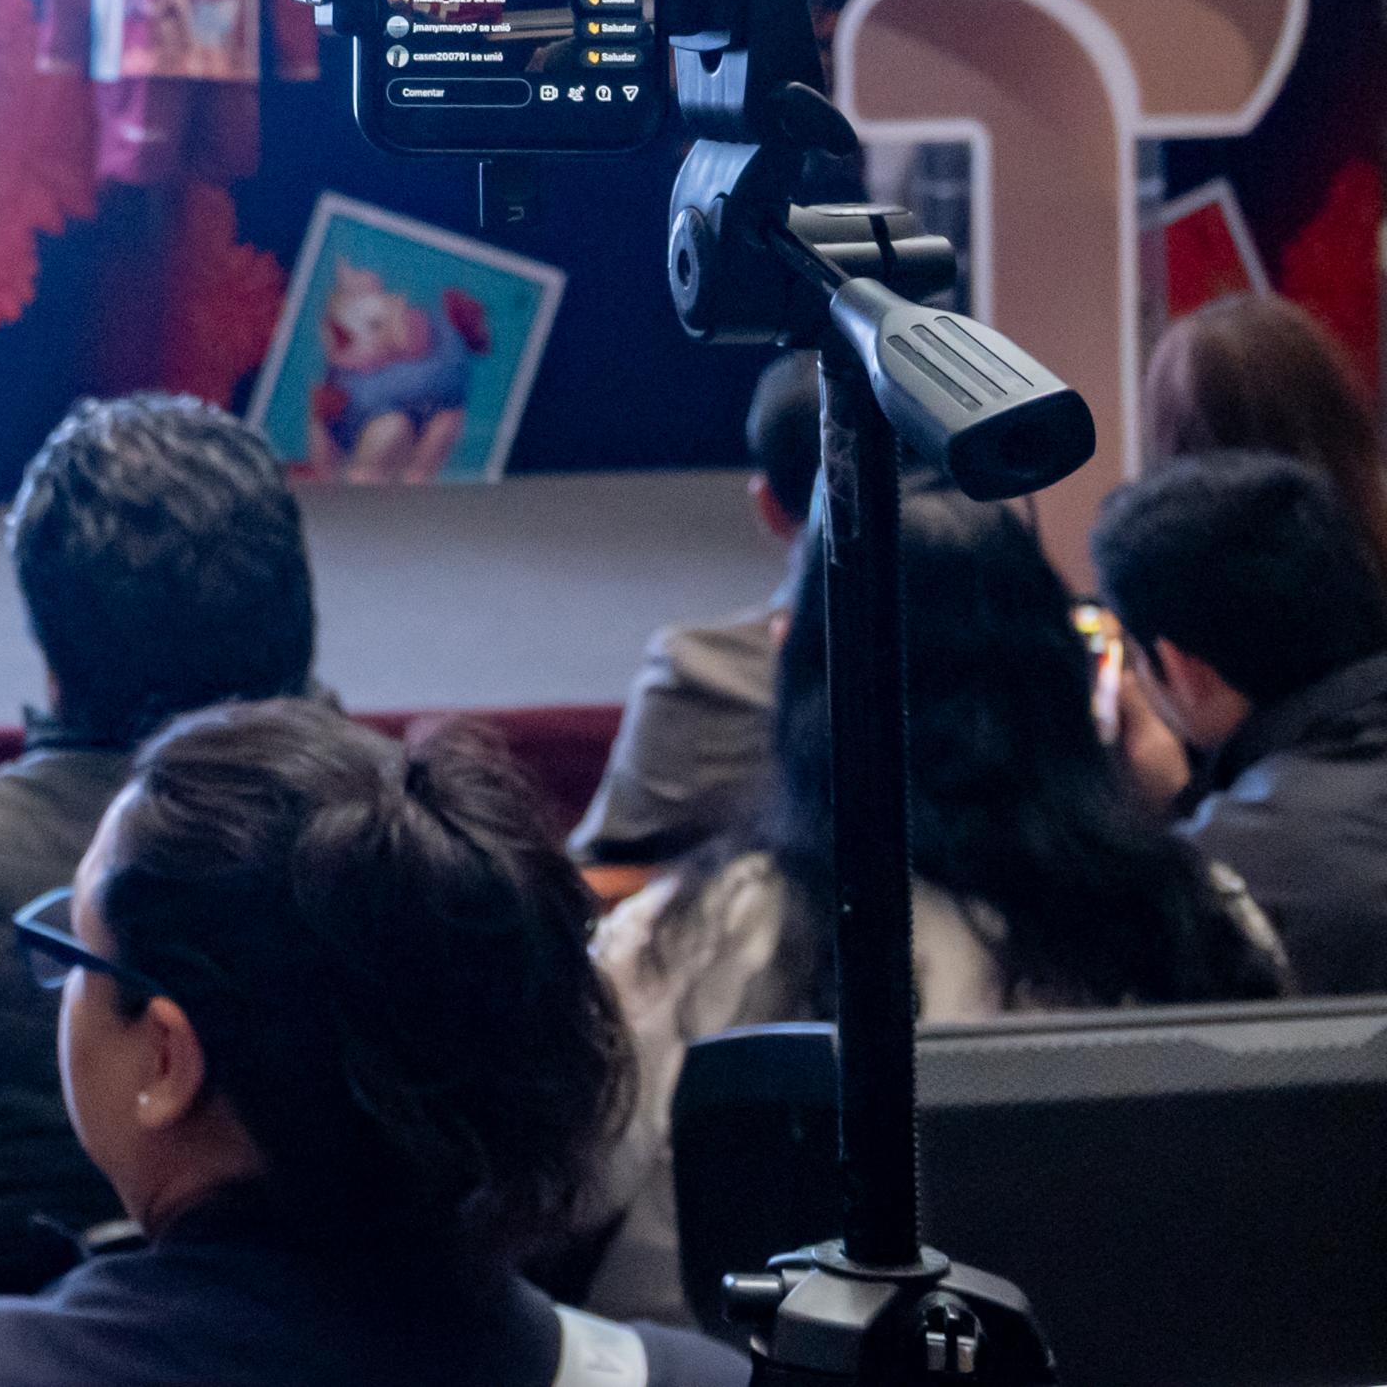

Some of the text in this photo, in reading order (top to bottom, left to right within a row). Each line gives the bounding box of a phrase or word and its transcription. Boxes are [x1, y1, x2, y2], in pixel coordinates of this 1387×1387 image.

[491, 22, 511, 32] unió
[601, 23, 636, 33] Saludar
[471, 54, 483, 62] se
[484, 52, 504, 62] unió
[601, 52, 636, 62] Saludar
[402, 88, 445, 97] Comentar
